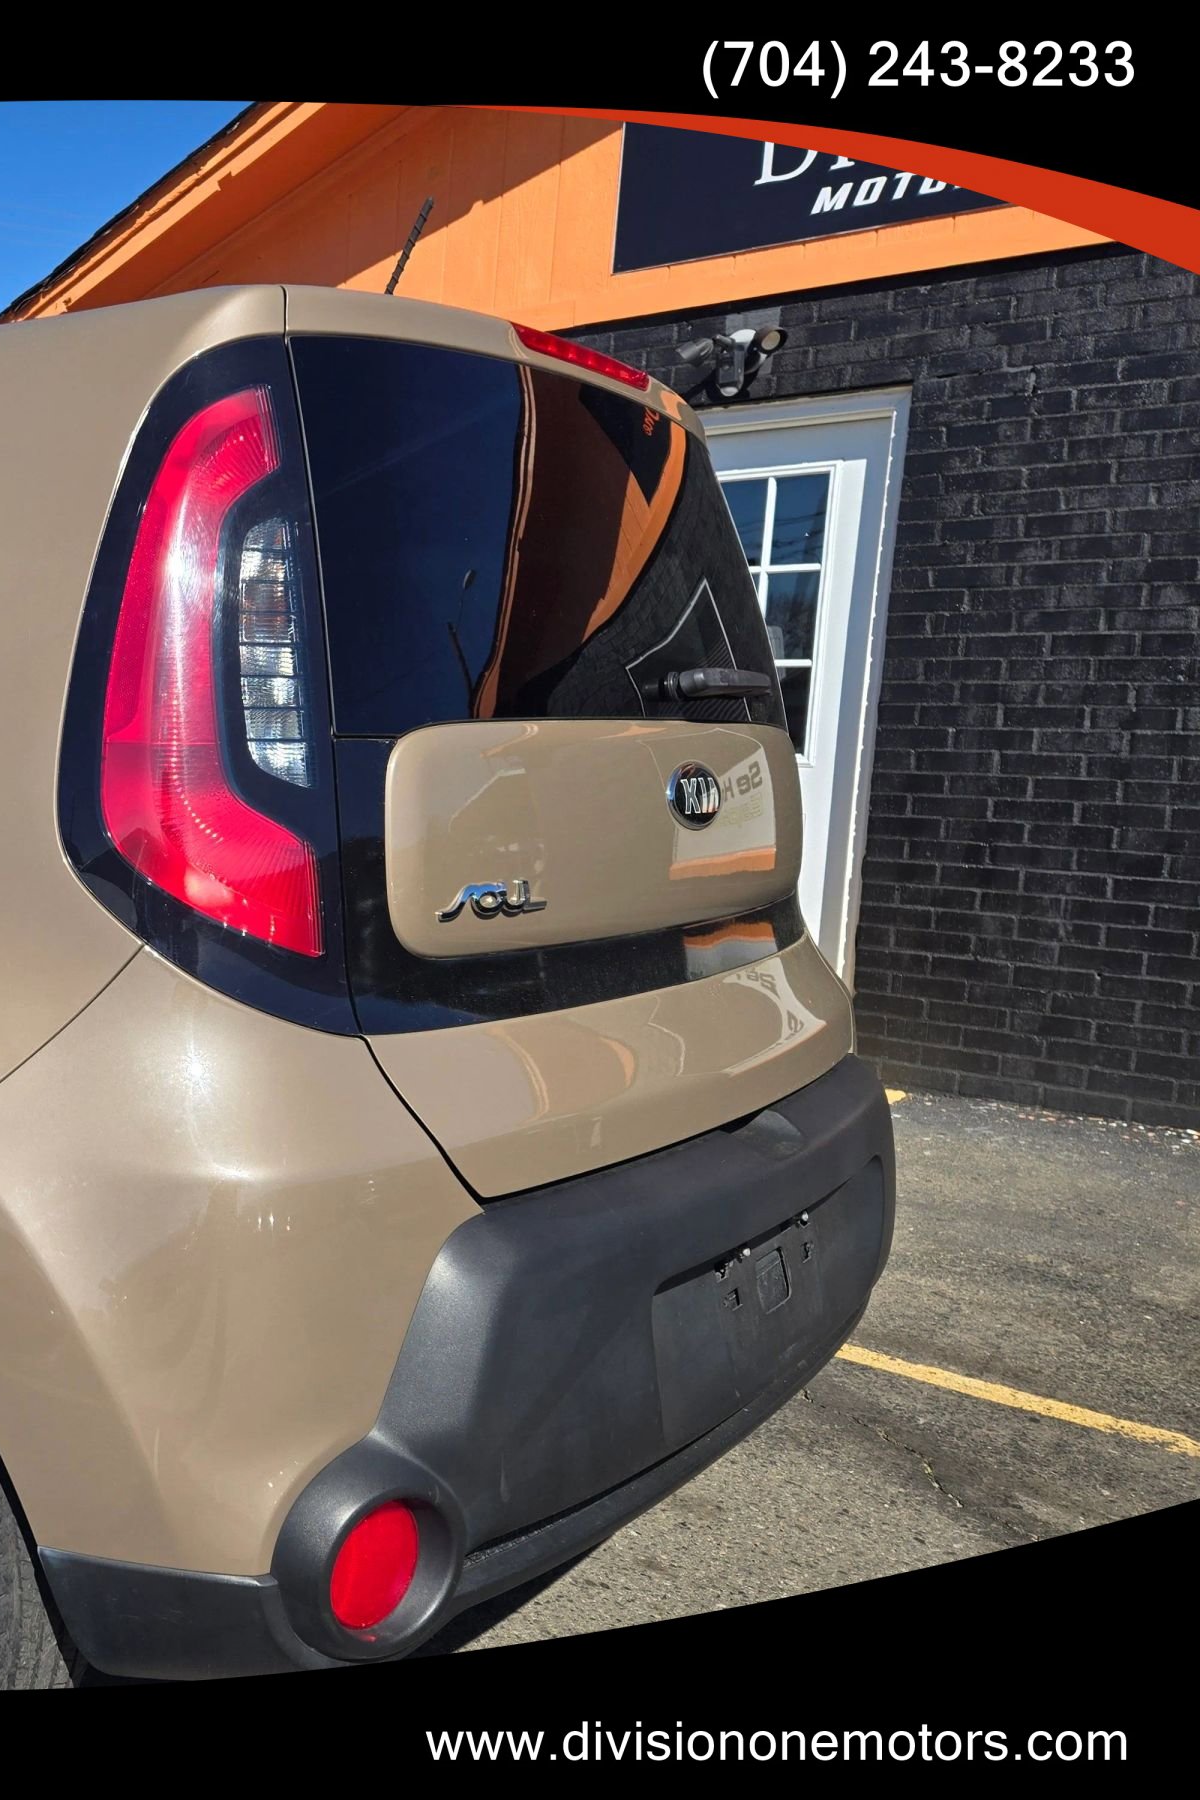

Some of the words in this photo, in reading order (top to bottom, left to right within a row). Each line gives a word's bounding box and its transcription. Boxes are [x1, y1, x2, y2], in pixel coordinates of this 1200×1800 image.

[809, 171, 962, 216] MOTO
[679, 776, 720, 815] KIA
[434, 879, 547, 922] SOUL
